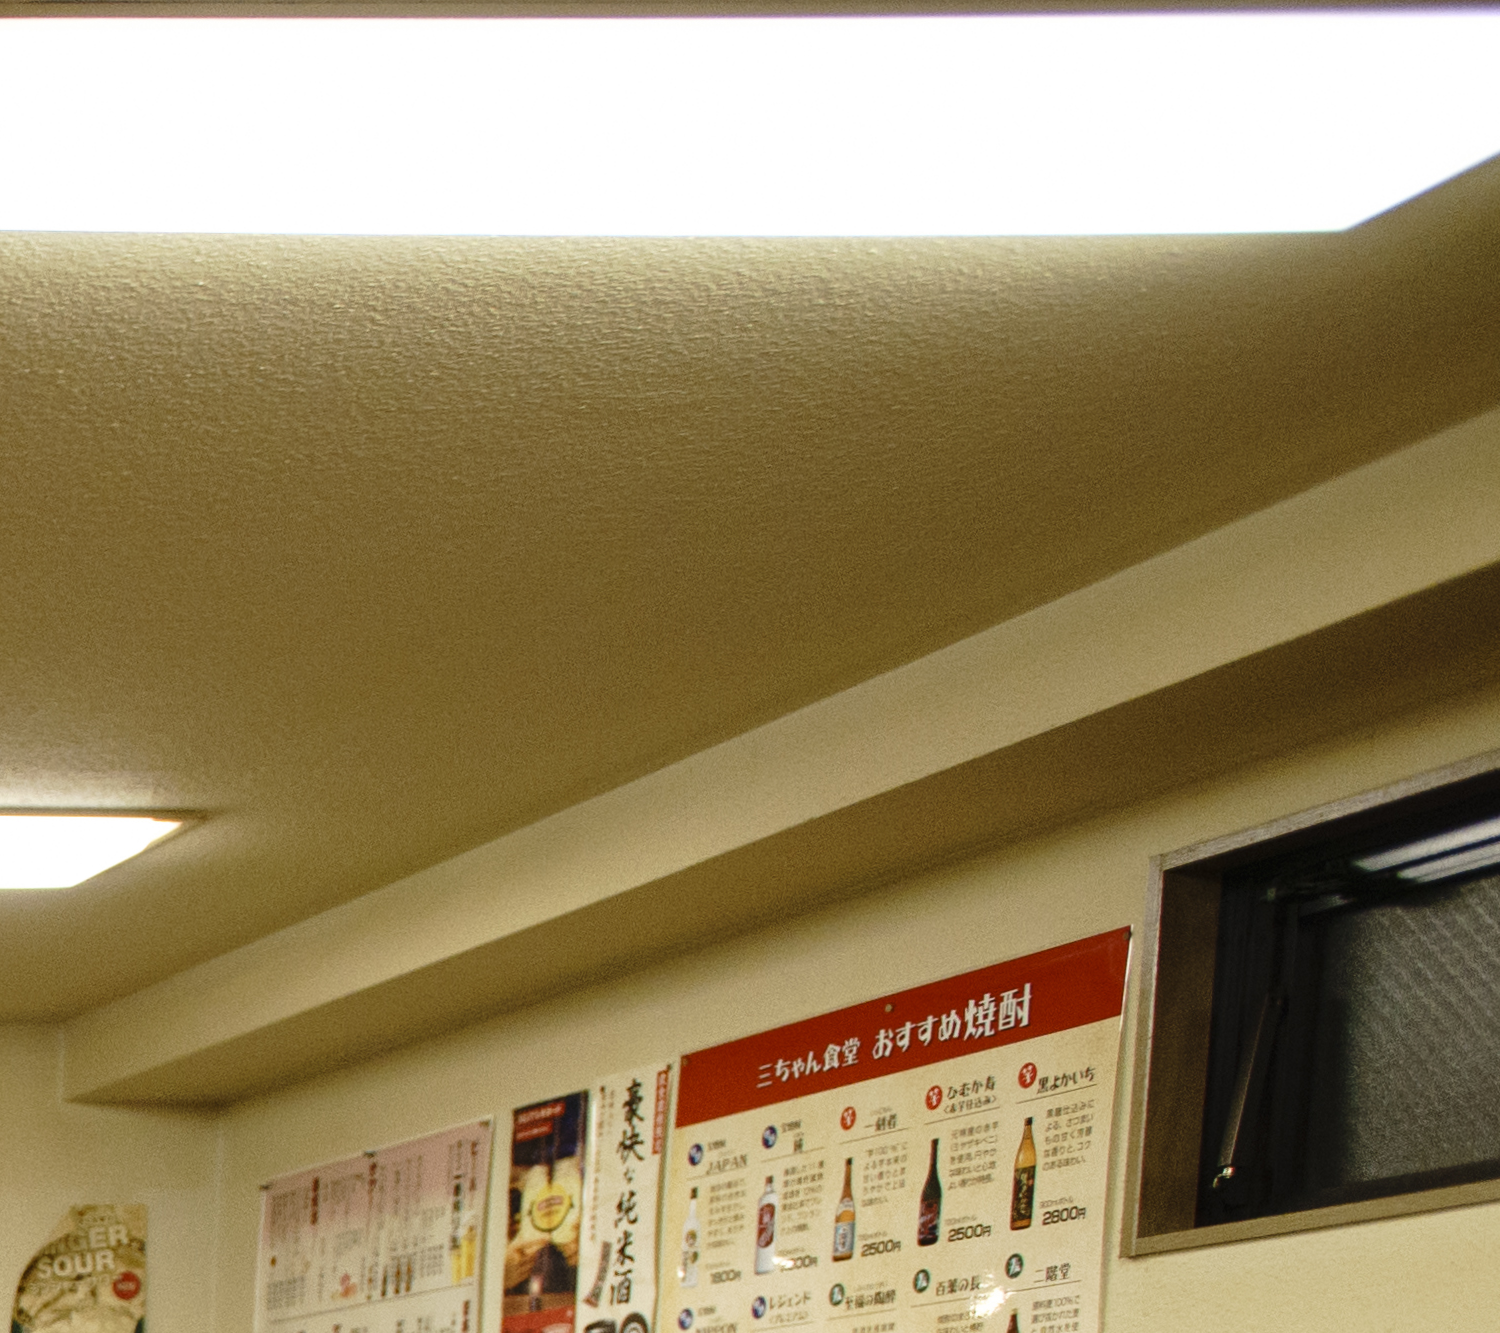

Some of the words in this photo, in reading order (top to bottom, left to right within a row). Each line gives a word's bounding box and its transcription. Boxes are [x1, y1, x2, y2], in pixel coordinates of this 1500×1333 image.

[755, 1036, 863, 1091] 三ちゃん食堂
[1041, 1205, 1088, 1227] 2800円
[947, 1223, 992, 1244] 2500円
[36, 1249, 116, 1279] SOUR
